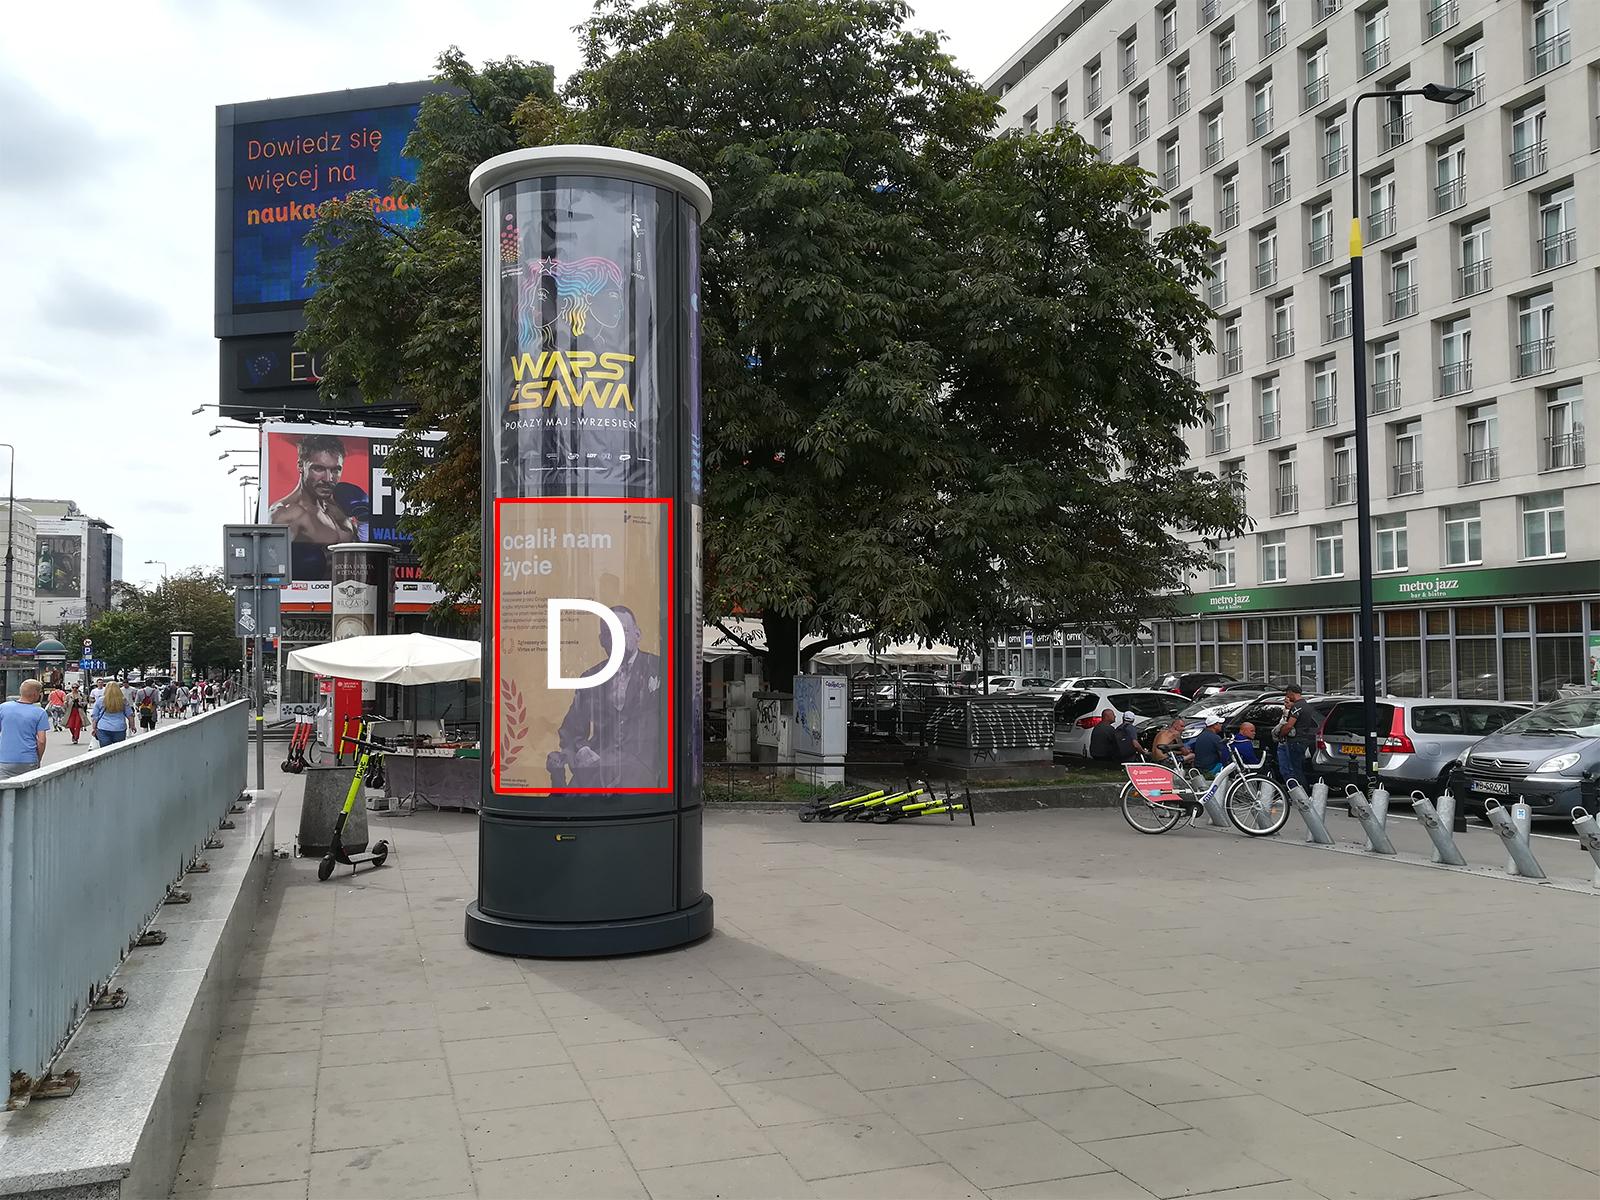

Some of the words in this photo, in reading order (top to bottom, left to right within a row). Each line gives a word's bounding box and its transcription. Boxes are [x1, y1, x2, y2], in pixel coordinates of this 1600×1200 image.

[248, 131, 341, 160] Dowiedz
[350, 127, 382, 152] się
[247, 164, 319, 194] więcej
[328, 164, 356, 183] na
[511, 351, 636, 382] WARS
[505, 418, 542, 431] POKAZY
[546, 417, 568, 427] MAJ
[578, 417, 637, 430] WRZESIEŃ
[503, 528, 557, 550] ocalił
[562, 532, 612, 549] nam
[503, 555, 553, 581] życie
[1399, 580, 1434, 592] metro
[1434, 577, 1459, 592] jazz
[1210, 595, 1233, 605] metro
[1233, 593, 1250, 606] jazz
[84, 647, 91, 655] P
